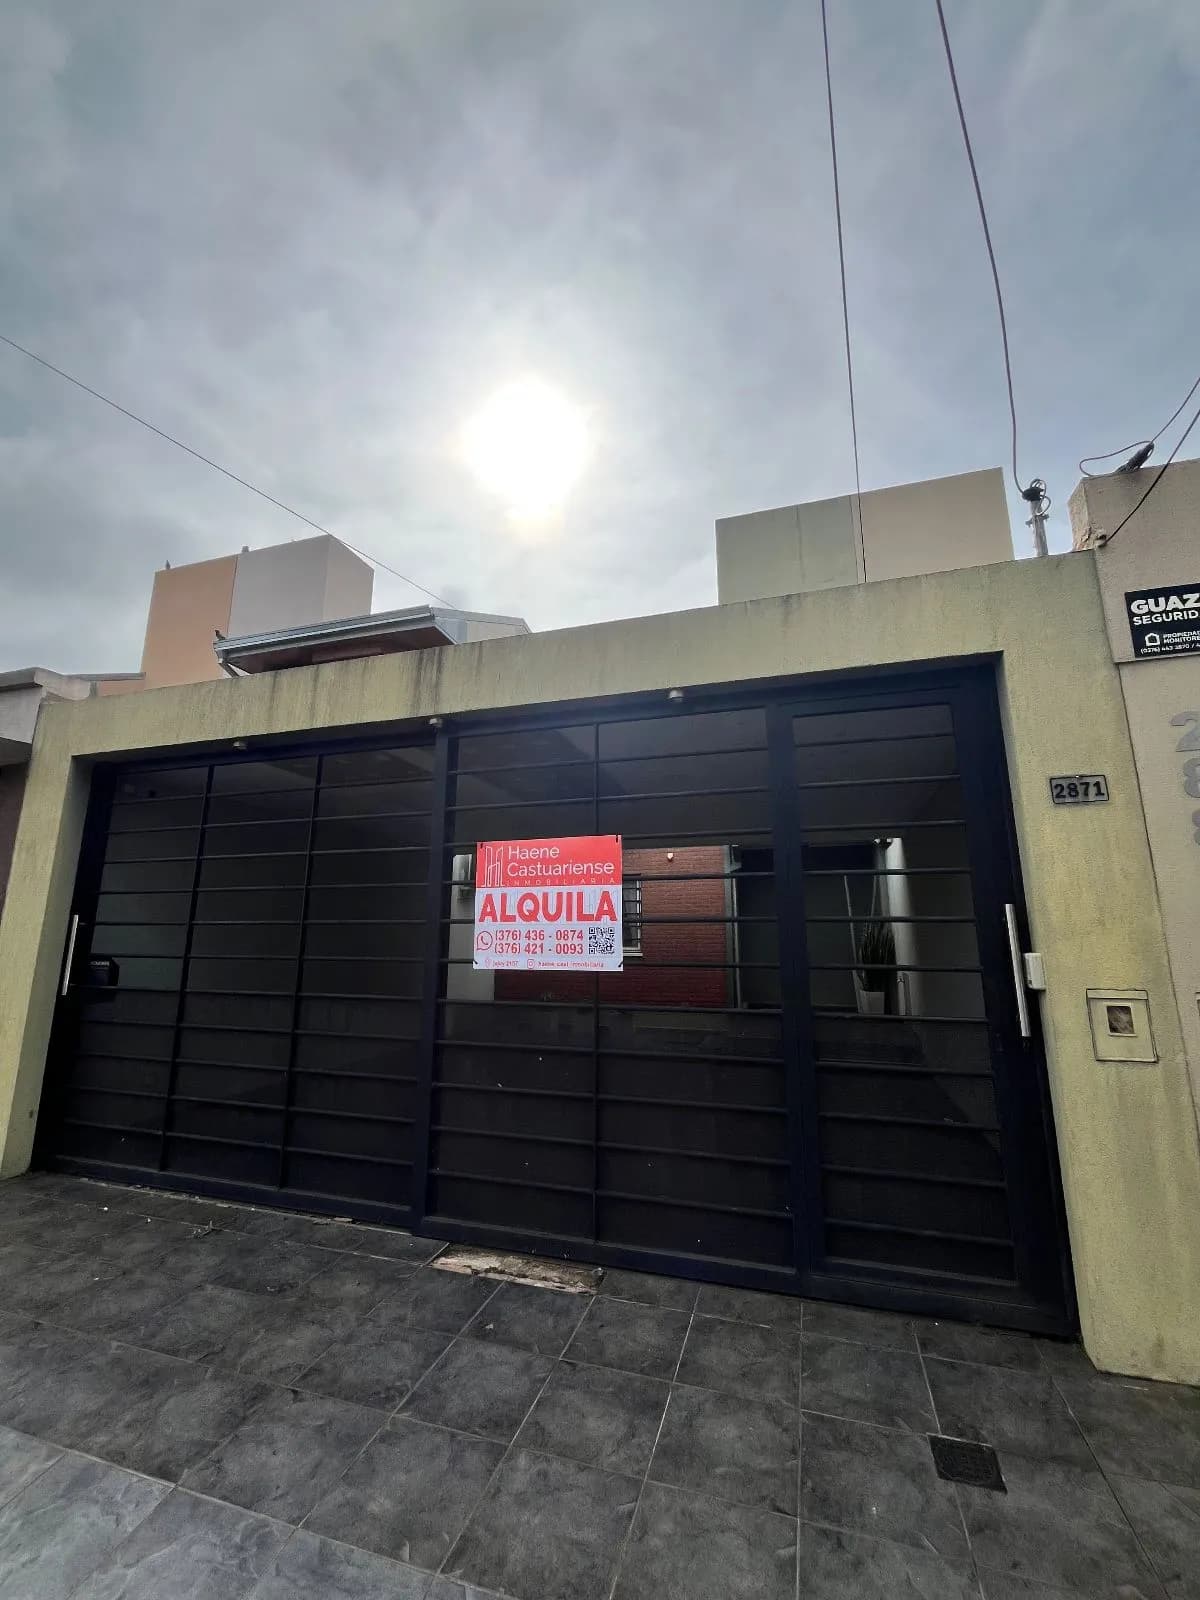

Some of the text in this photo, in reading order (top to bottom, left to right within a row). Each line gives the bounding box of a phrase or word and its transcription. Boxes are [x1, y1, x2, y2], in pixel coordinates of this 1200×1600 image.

[1133, 610, 1199, 625] SEGURID
[1054, 781, 1105, 798] 2871
[508, 845, 560, 860] Haene
[507, 860, 615, 877] Castuariense
[507, 877, 615, 886] INMOBILIARIA
[479, 891, 617, 922] ALQUILA
[495, 929, 520, 941] (376)
[525, 929, 545, 941] 436
[555, 929, 584, 941] 0874
[495, 943, 520, 955] (376)
[525, 943, 544, 954] 421
[555, 943, 584, 954] 0093
